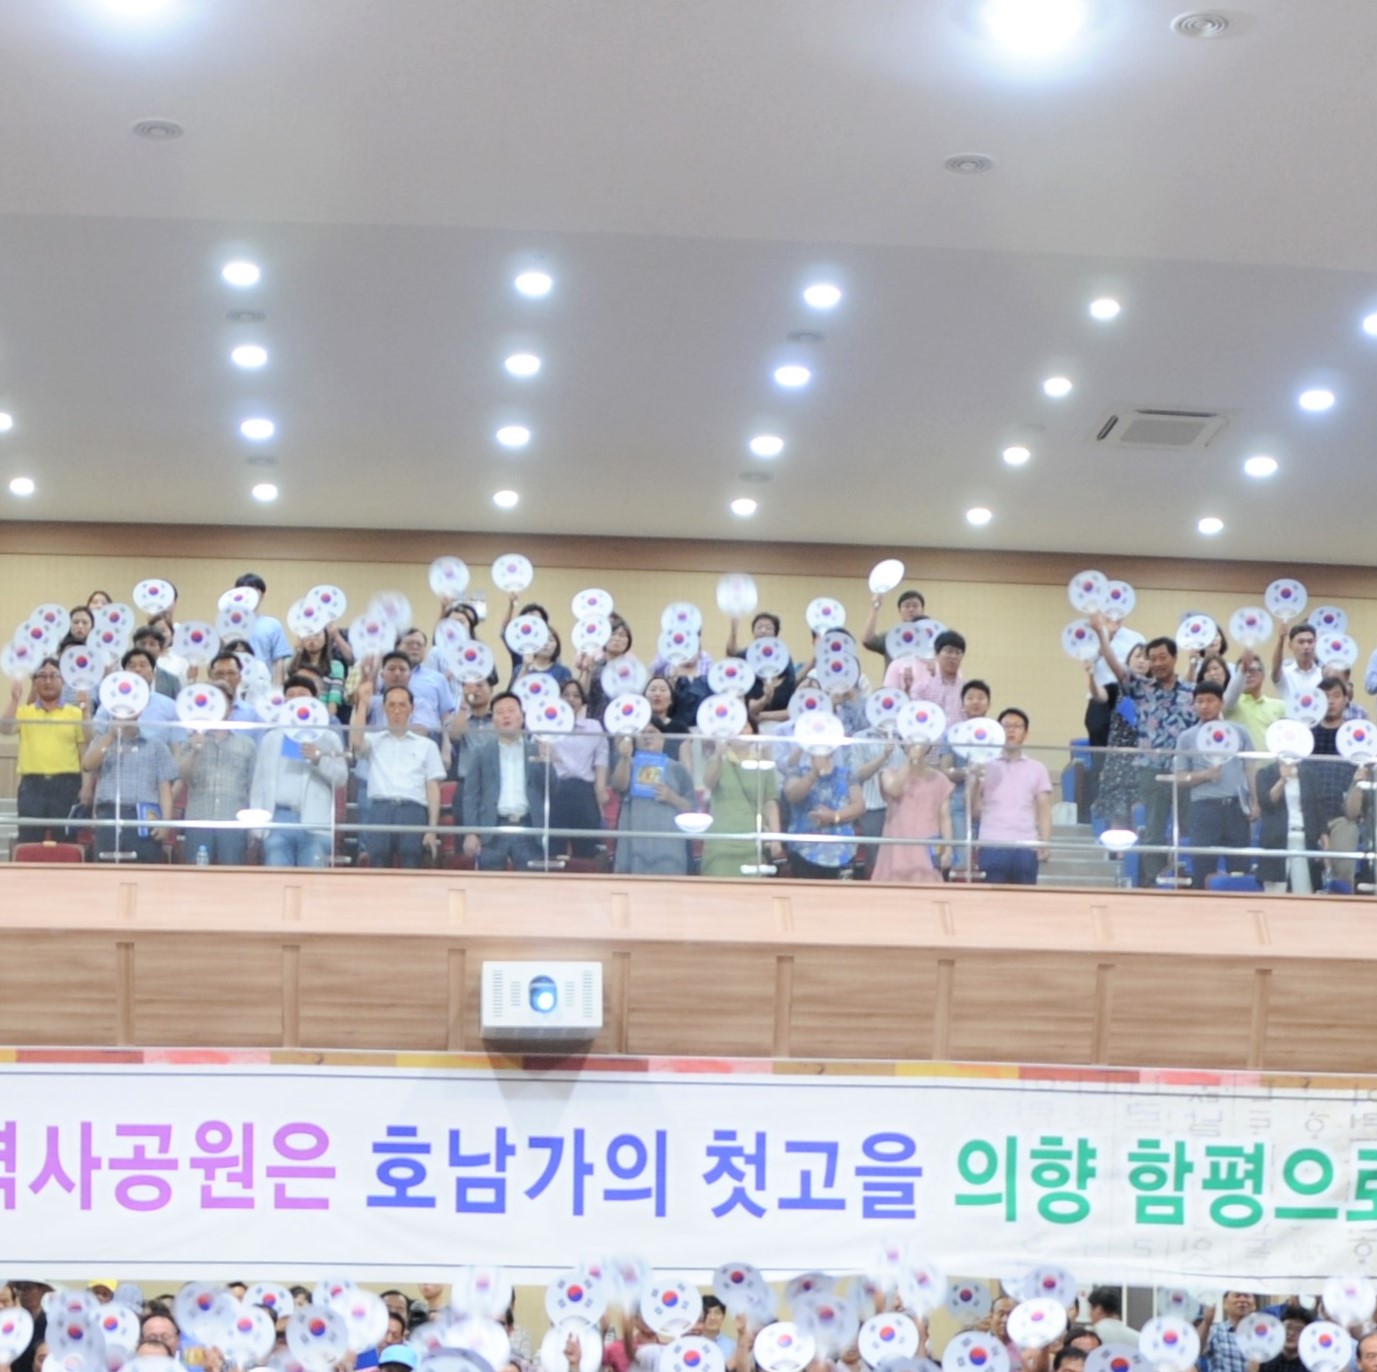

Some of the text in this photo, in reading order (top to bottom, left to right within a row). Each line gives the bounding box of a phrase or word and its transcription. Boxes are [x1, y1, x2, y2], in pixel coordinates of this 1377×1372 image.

[365, 1124, 668, 1219] 호남가의
[702, 1128, 924, 1220] 첫고을
[954, 1135, 1099, 1226] 의향
